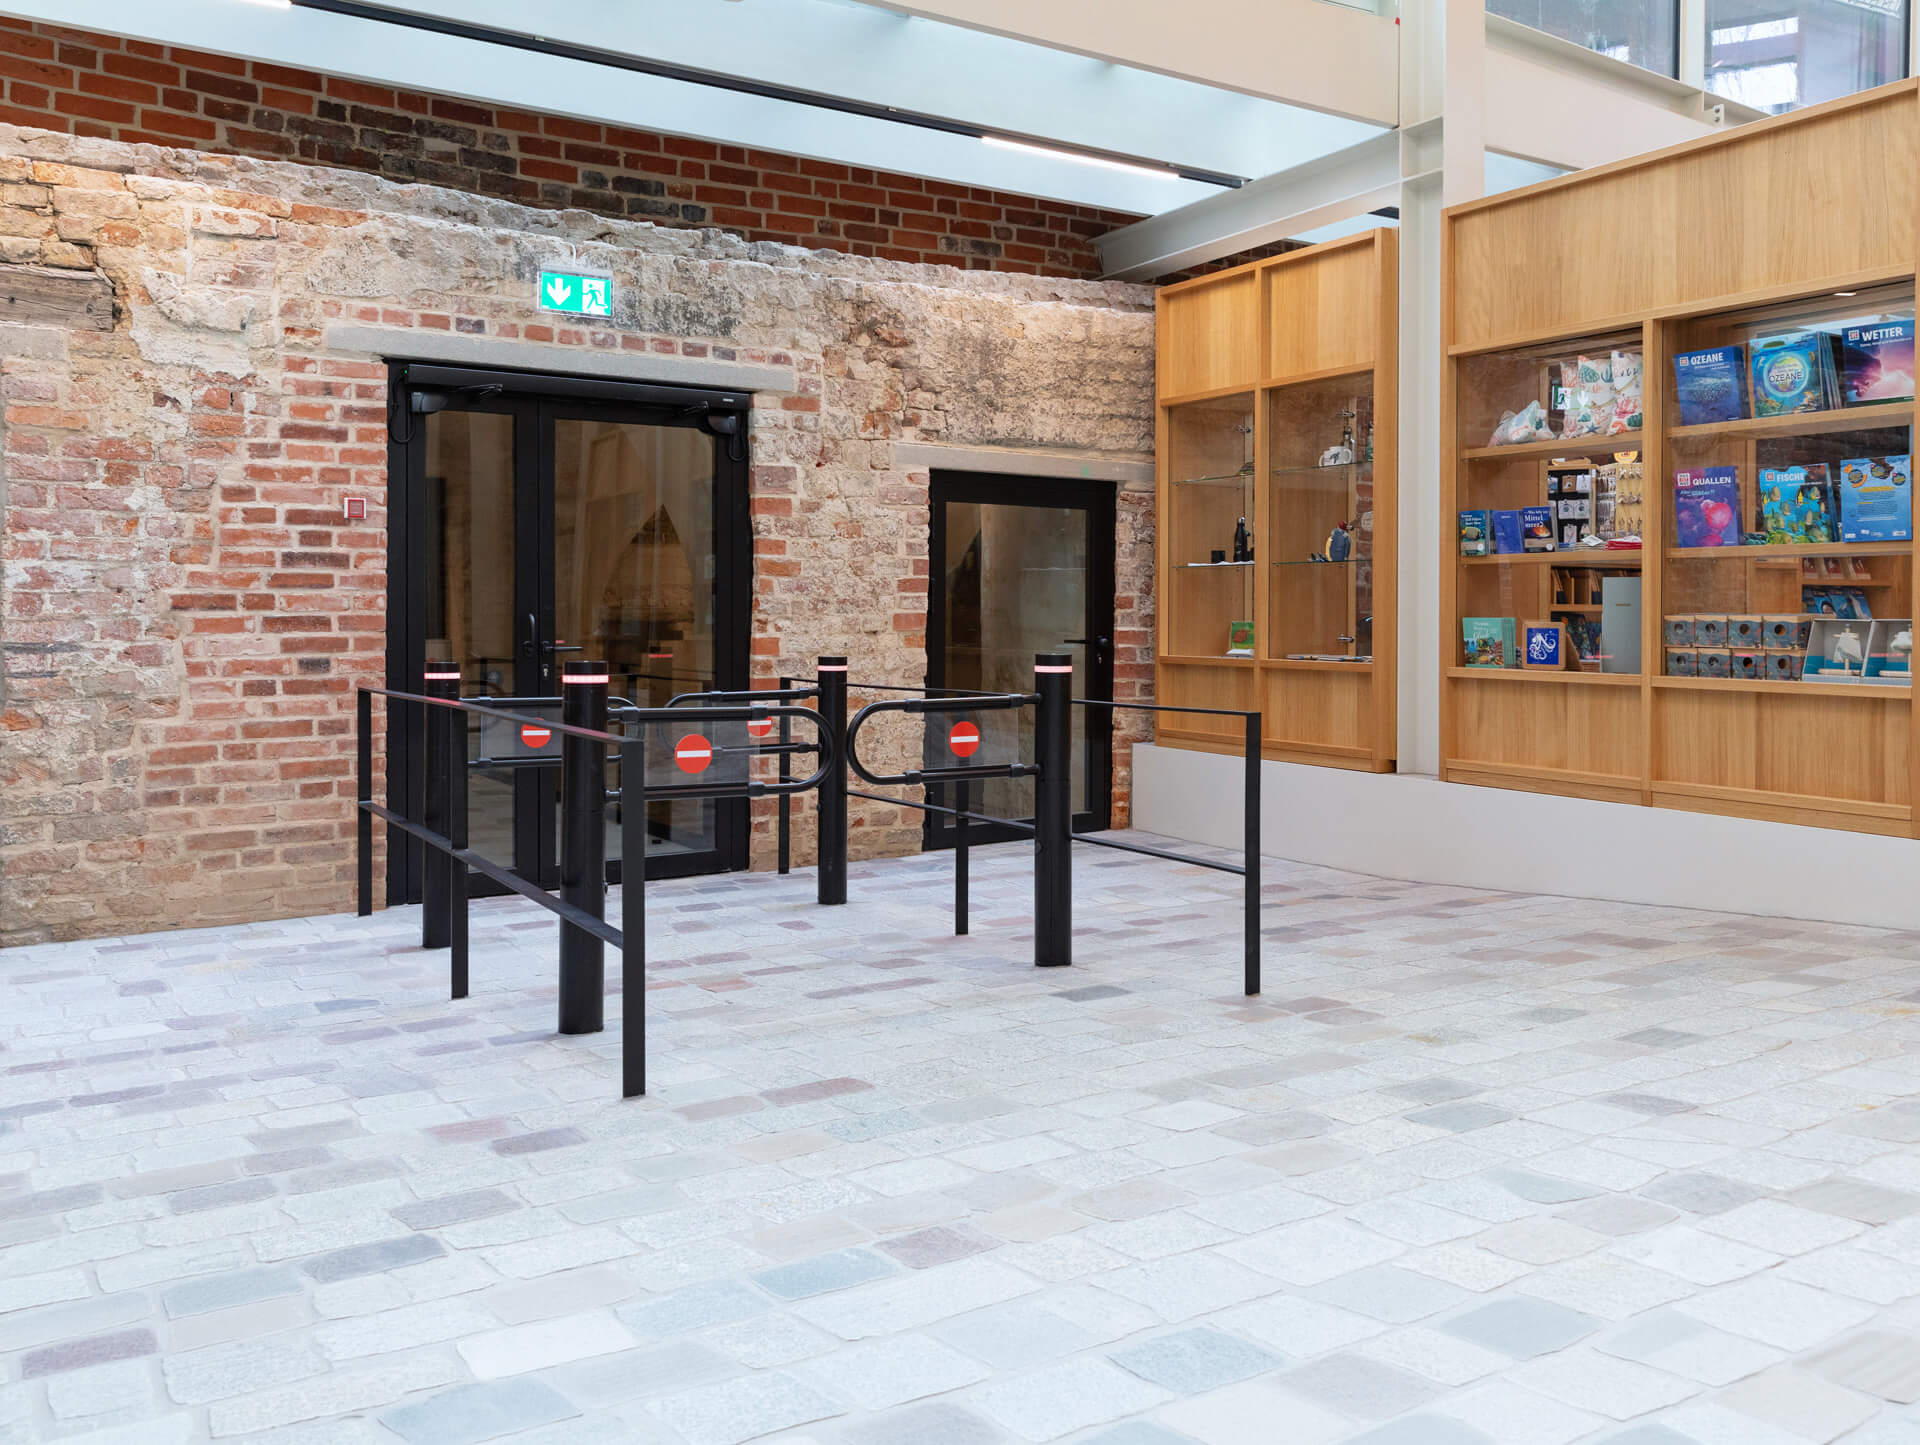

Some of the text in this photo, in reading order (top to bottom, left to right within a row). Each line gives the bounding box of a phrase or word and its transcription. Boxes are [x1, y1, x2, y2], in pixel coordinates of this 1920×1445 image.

[1862, 326, 1903, 341] WETTER
[1690, 352, 1724, 365] OZEANE
[1768, 370, 1803, 383] OZEANE
[1692, 476, 1732, 486] QUALLEN
